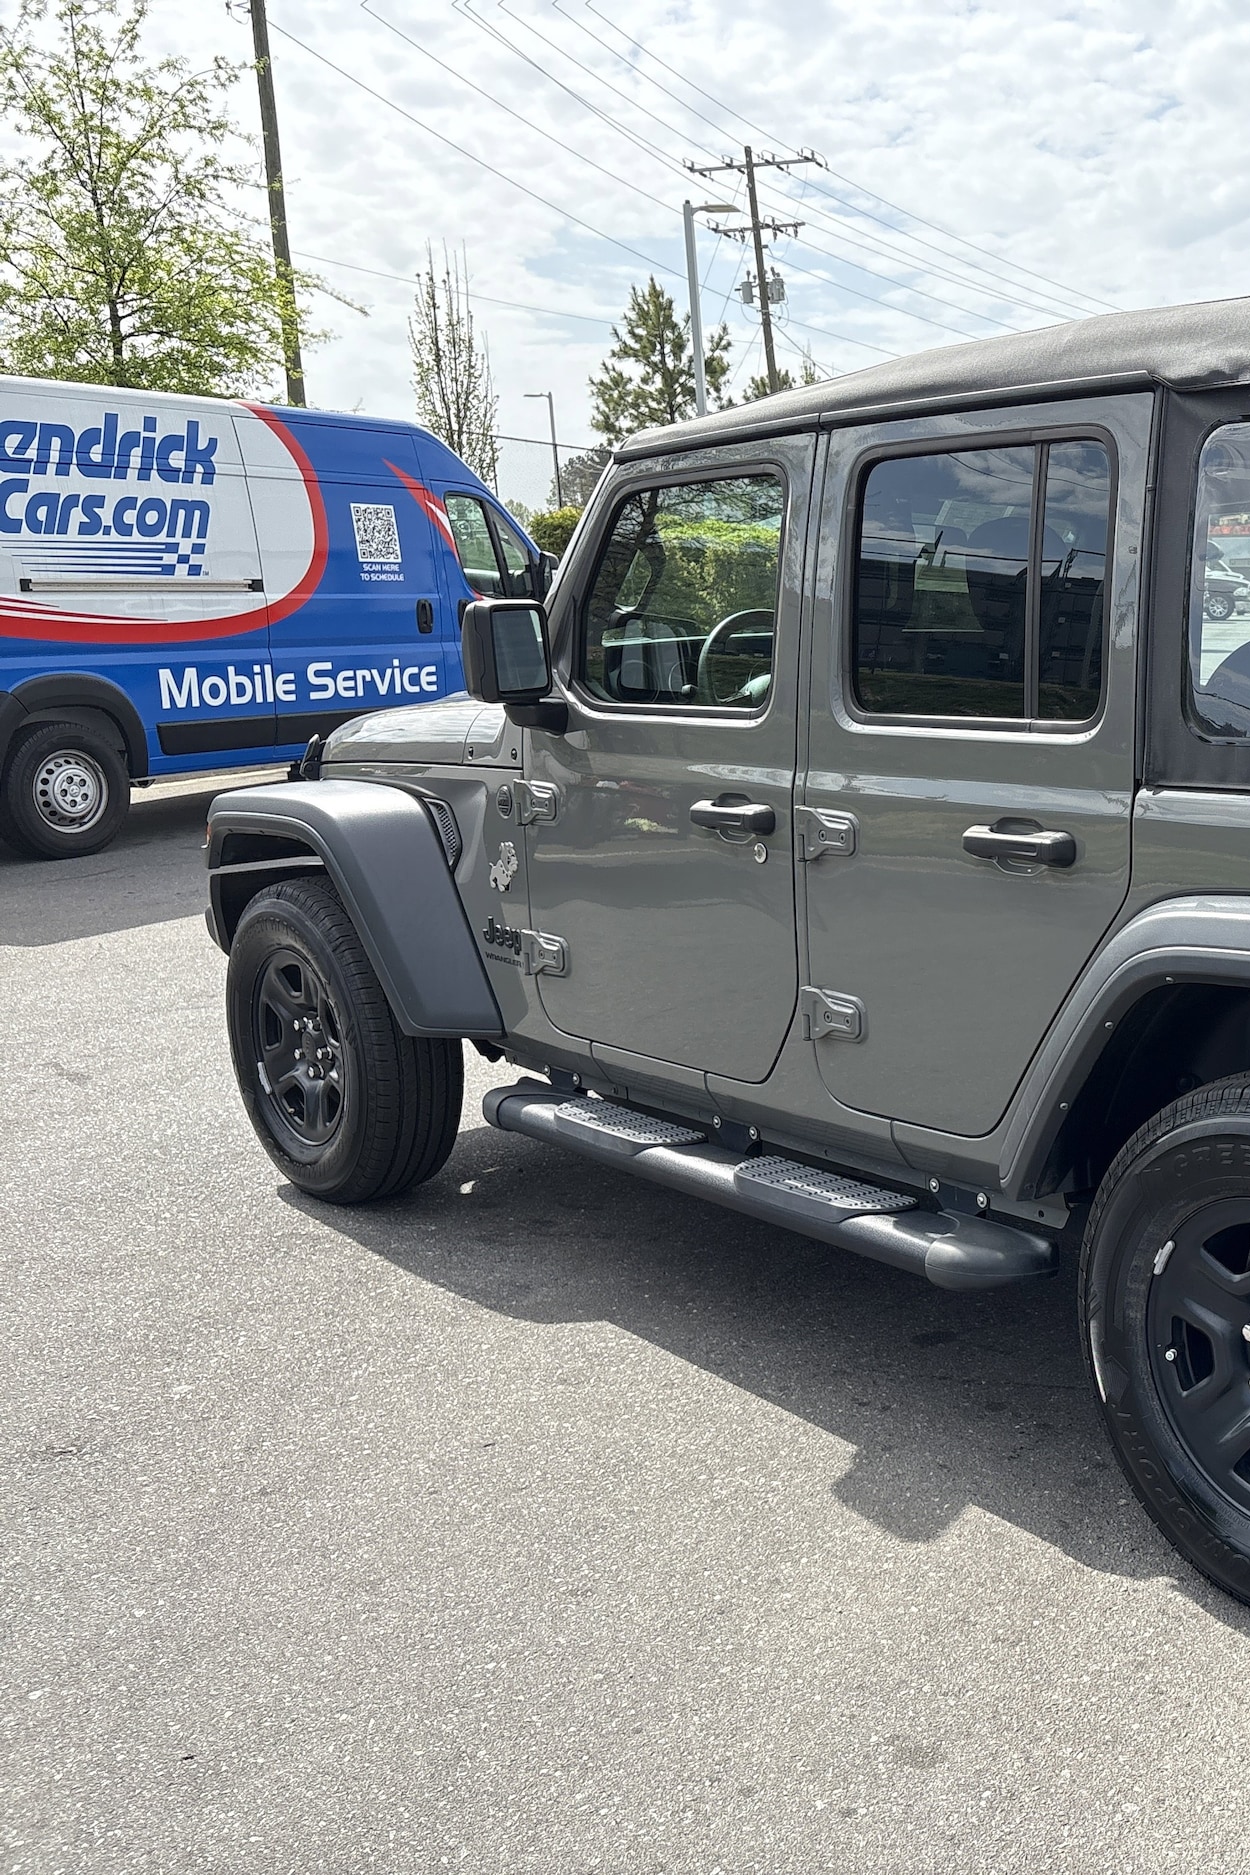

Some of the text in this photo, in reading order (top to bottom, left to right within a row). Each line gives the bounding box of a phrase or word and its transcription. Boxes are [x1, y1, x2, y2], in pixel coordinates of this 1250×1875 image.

[0, 478, 210, 538] Cars.com
[371, 573, 404, 581] SCHEDULE
[158, 659, 437, 709] Mobile Service
[483, 915, 522, 955] Jeep
